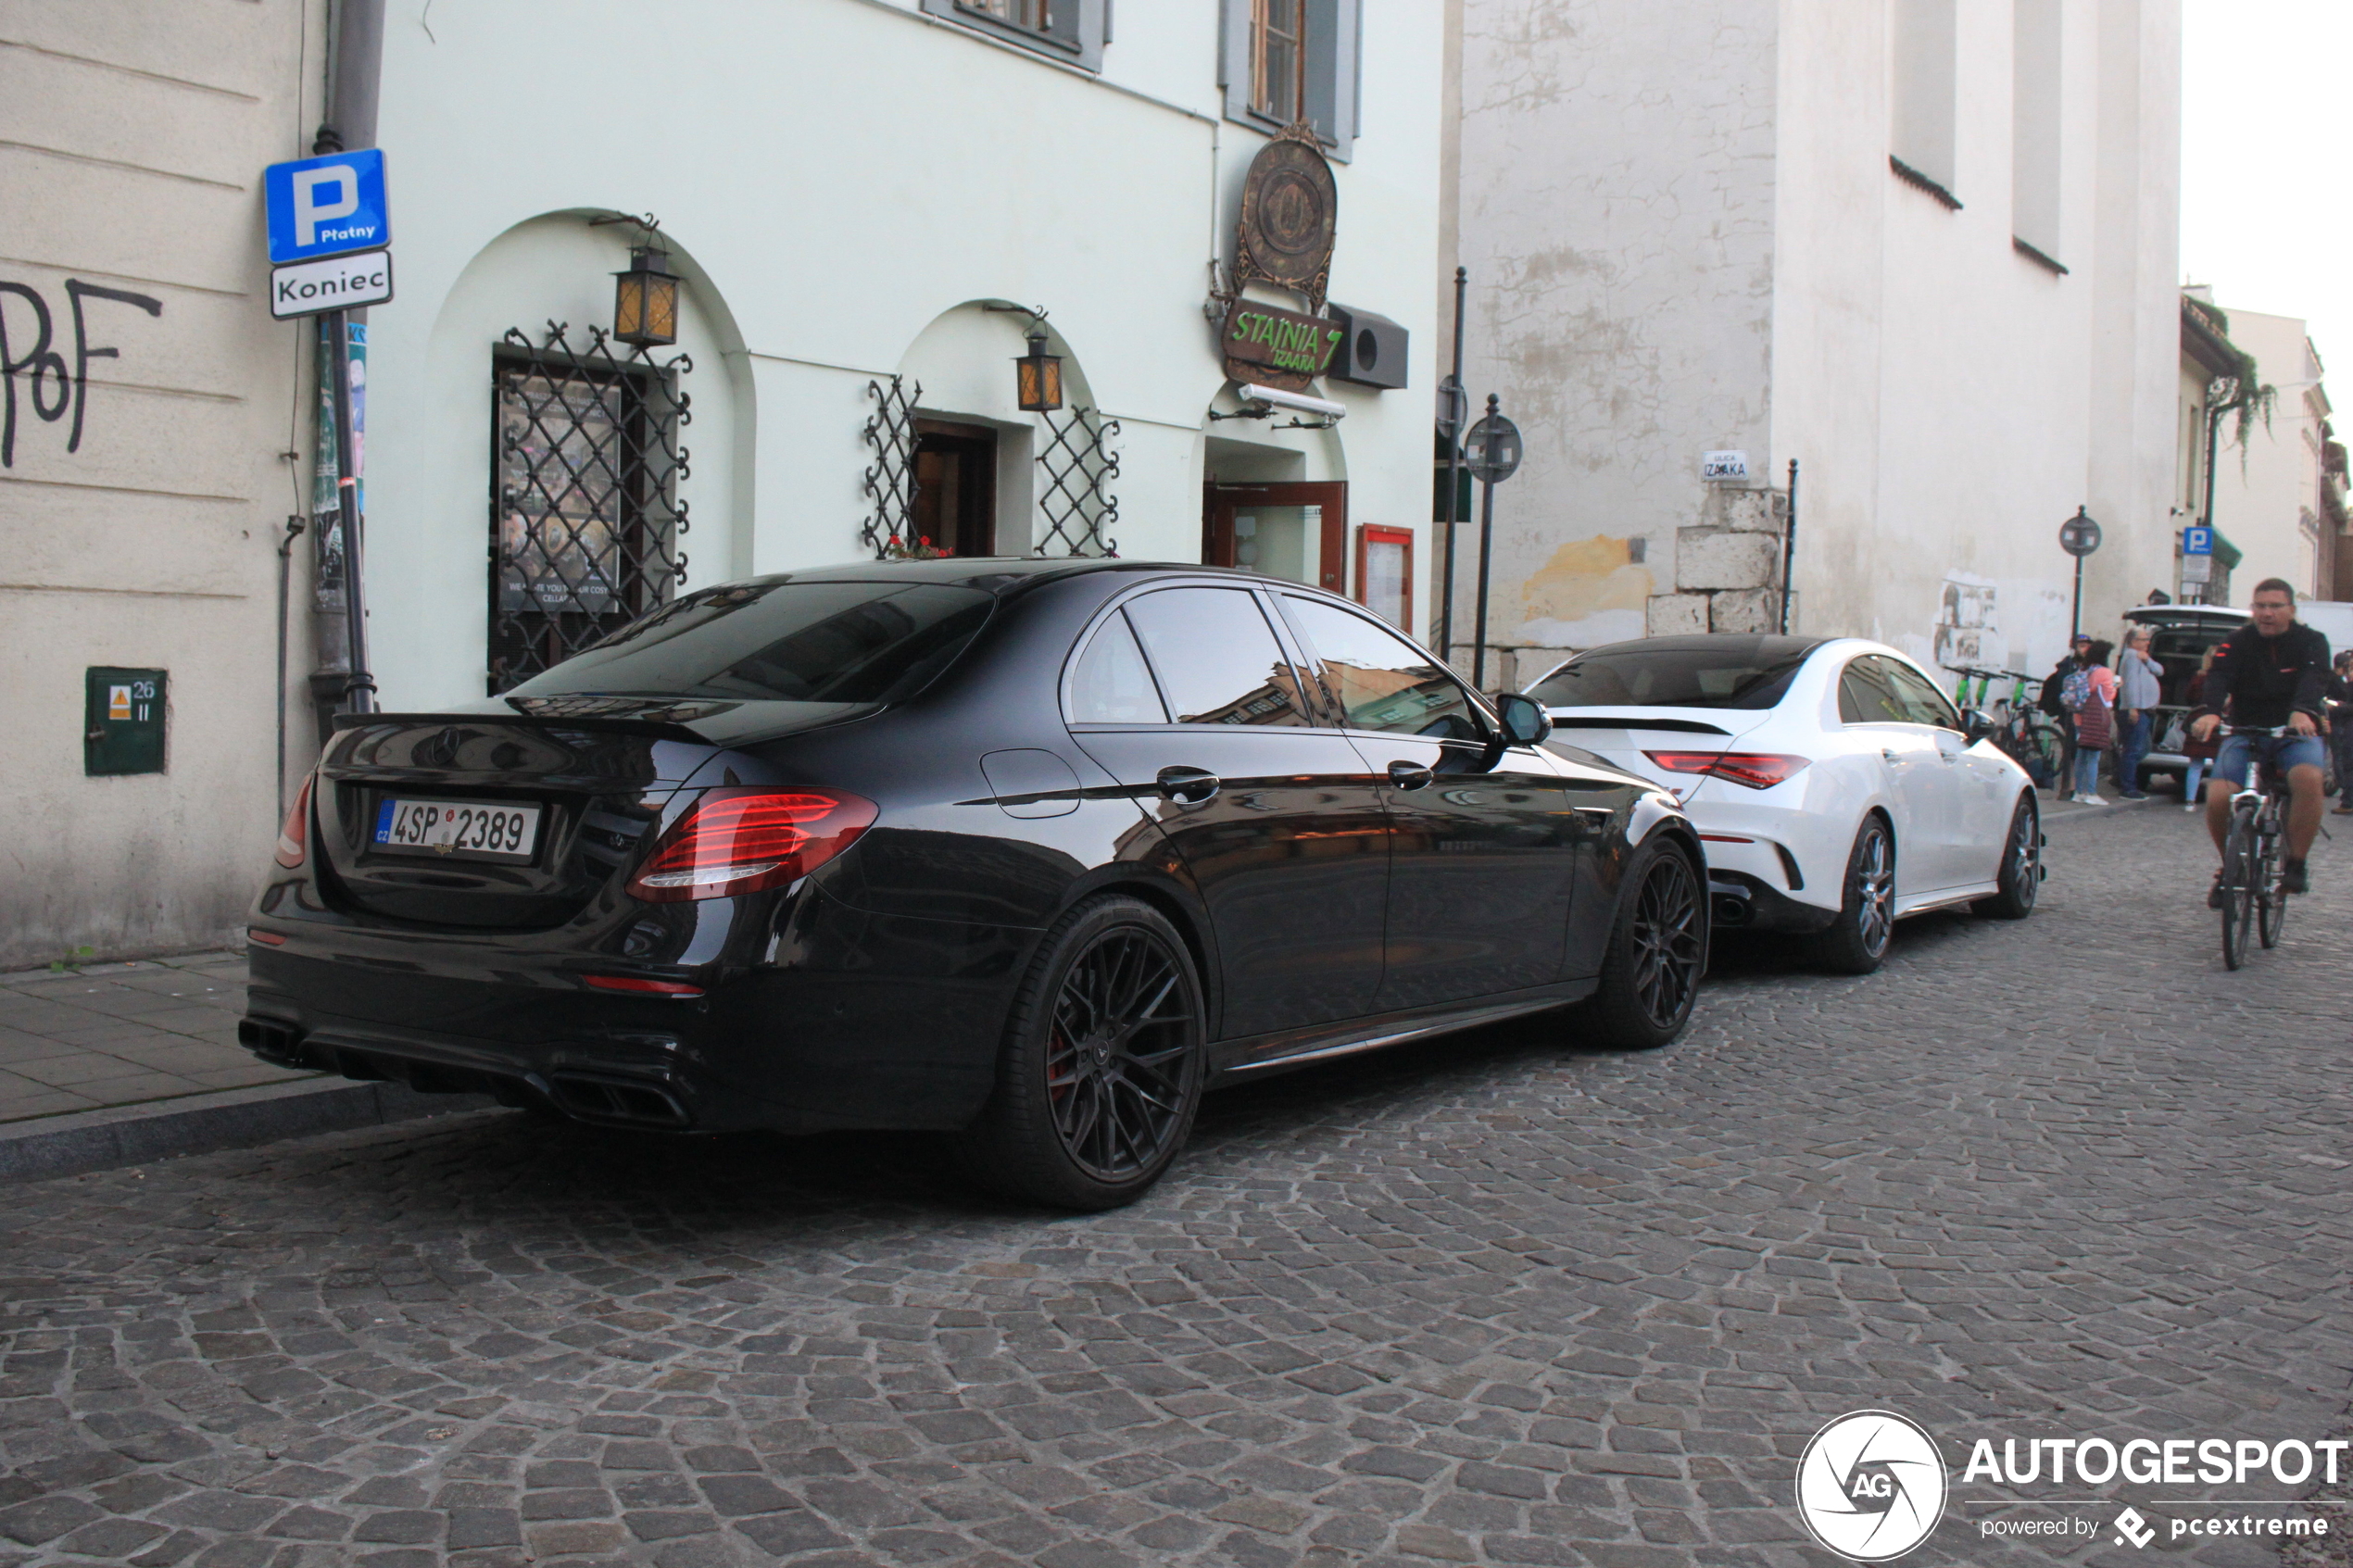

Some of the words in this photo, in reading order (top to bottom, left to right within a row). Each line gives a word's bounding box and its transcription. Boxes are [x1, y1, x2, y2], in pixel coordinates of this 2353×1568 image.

[292, 164, 359, 248] P
[279, 271, 384, 303] Koniec
[547, 584, 561, 593] YOU
[590, 586, 608, 595] COSY
[133, 681, 156, 699] 26
[376, 830, 389, 842] CZ
[395, 806, 439, 844] 4SP
[455, 809, 525, 851] 2389
